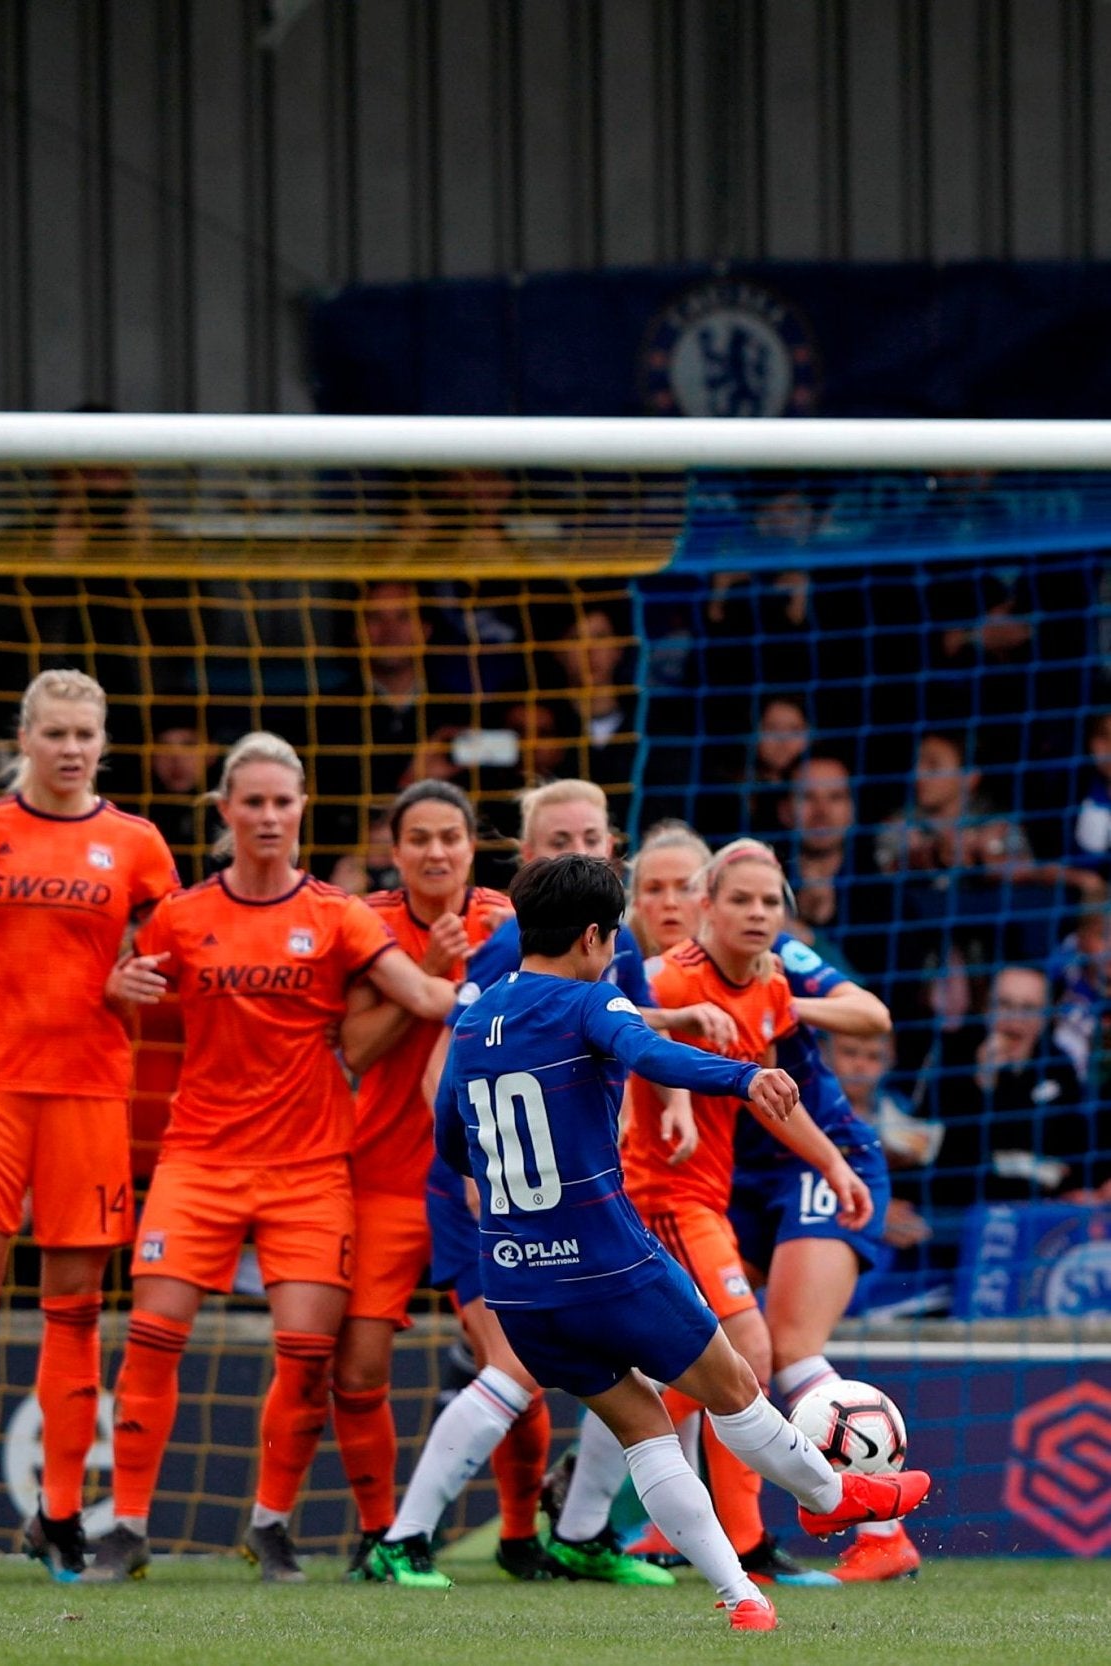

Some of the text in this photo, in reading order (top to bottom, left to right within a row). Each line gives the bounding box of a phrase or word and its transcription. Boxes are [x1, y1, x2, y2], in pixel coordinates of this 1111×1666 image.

[197, 965, 315, 992] SWORD
[485, 1015, 505, 1047] JI
[467, 1071, 562, 1214] 10
[95, 1182, 130, 1235] 14
[800, 1172, 838, 1216] 16
[525, 1239, 579, 1260] PLAN
[528, 1256, 580, 1268] INTERNATIONAL
